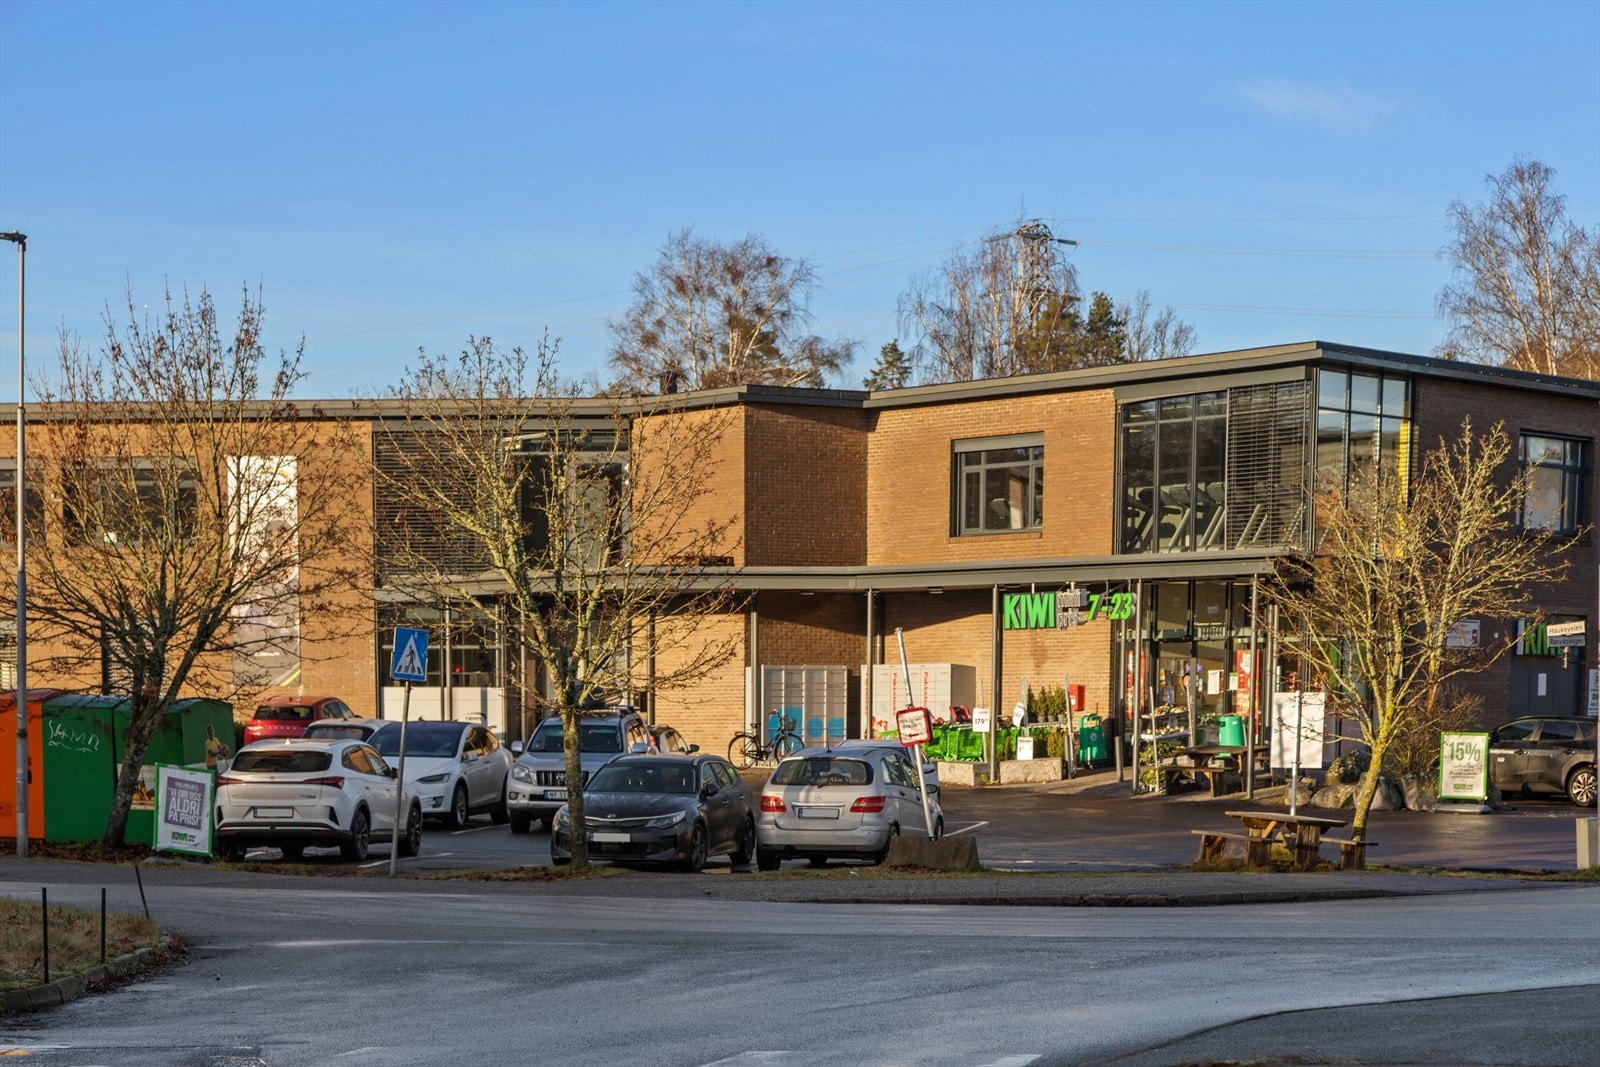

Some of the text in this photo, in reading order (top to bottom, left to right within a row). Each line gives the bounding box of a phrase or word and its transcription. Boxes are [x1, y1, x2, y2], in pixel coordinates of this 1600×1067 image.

[1057, 589, 1081, 608] mini
[1003, 592, 1133, 629] KIWI 7-23
[1057, 608, 1080, 630] pris
[1549, 624, 1583, 634] Haukeveien
[1550, 636, 1583, 647] Ranvikskogen
[1449, 742, 1480, 761] 15%
[178, 789, 189, 799] GIR
[189, 791, 202, 802] OSS
[169, 796, 201, 816] ALDRI
